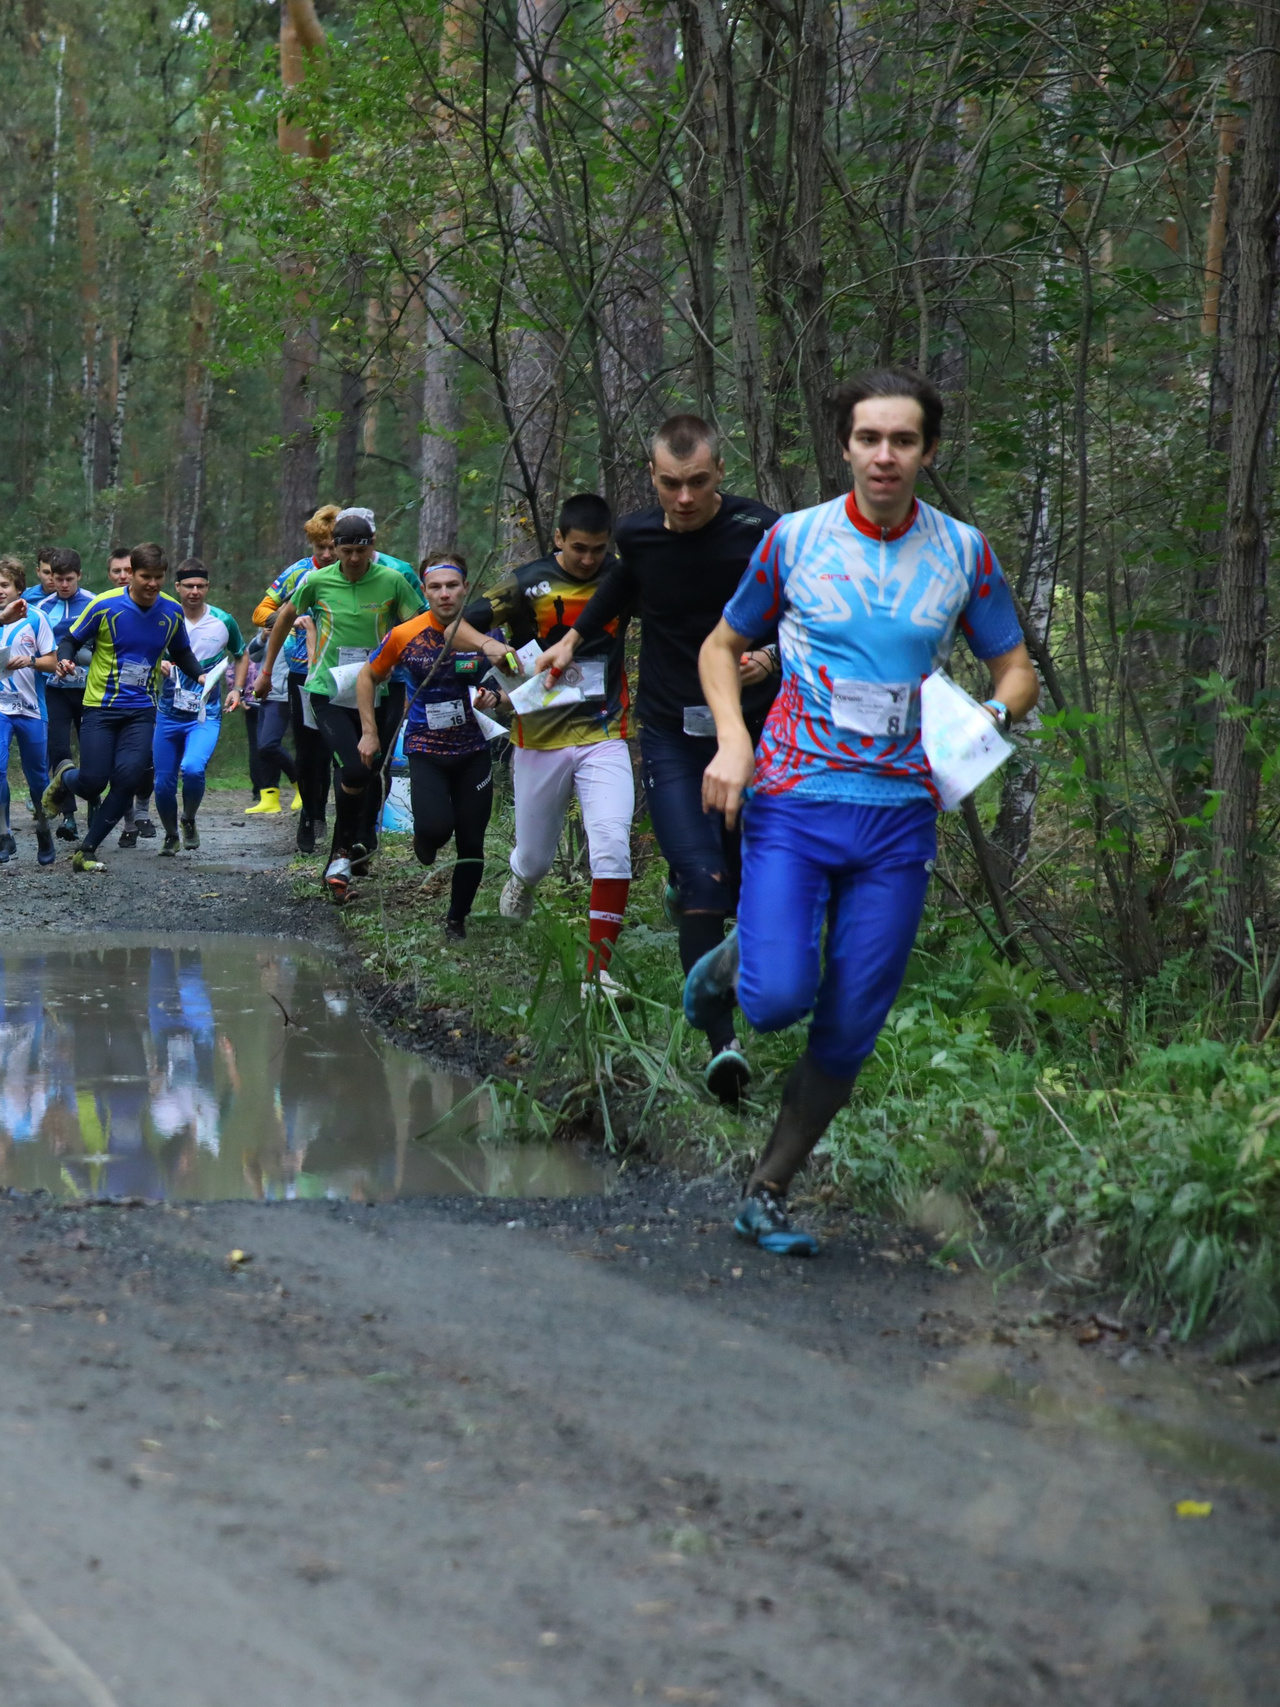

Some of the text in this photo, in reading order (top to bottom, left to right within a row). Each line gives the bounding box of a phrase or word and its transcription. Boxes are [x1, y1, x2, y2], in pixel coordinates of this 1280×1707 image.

[11, 702, 22, 711] 23
[451, 715, 464, 726] 16
[887, 715, 900, 736] 8
